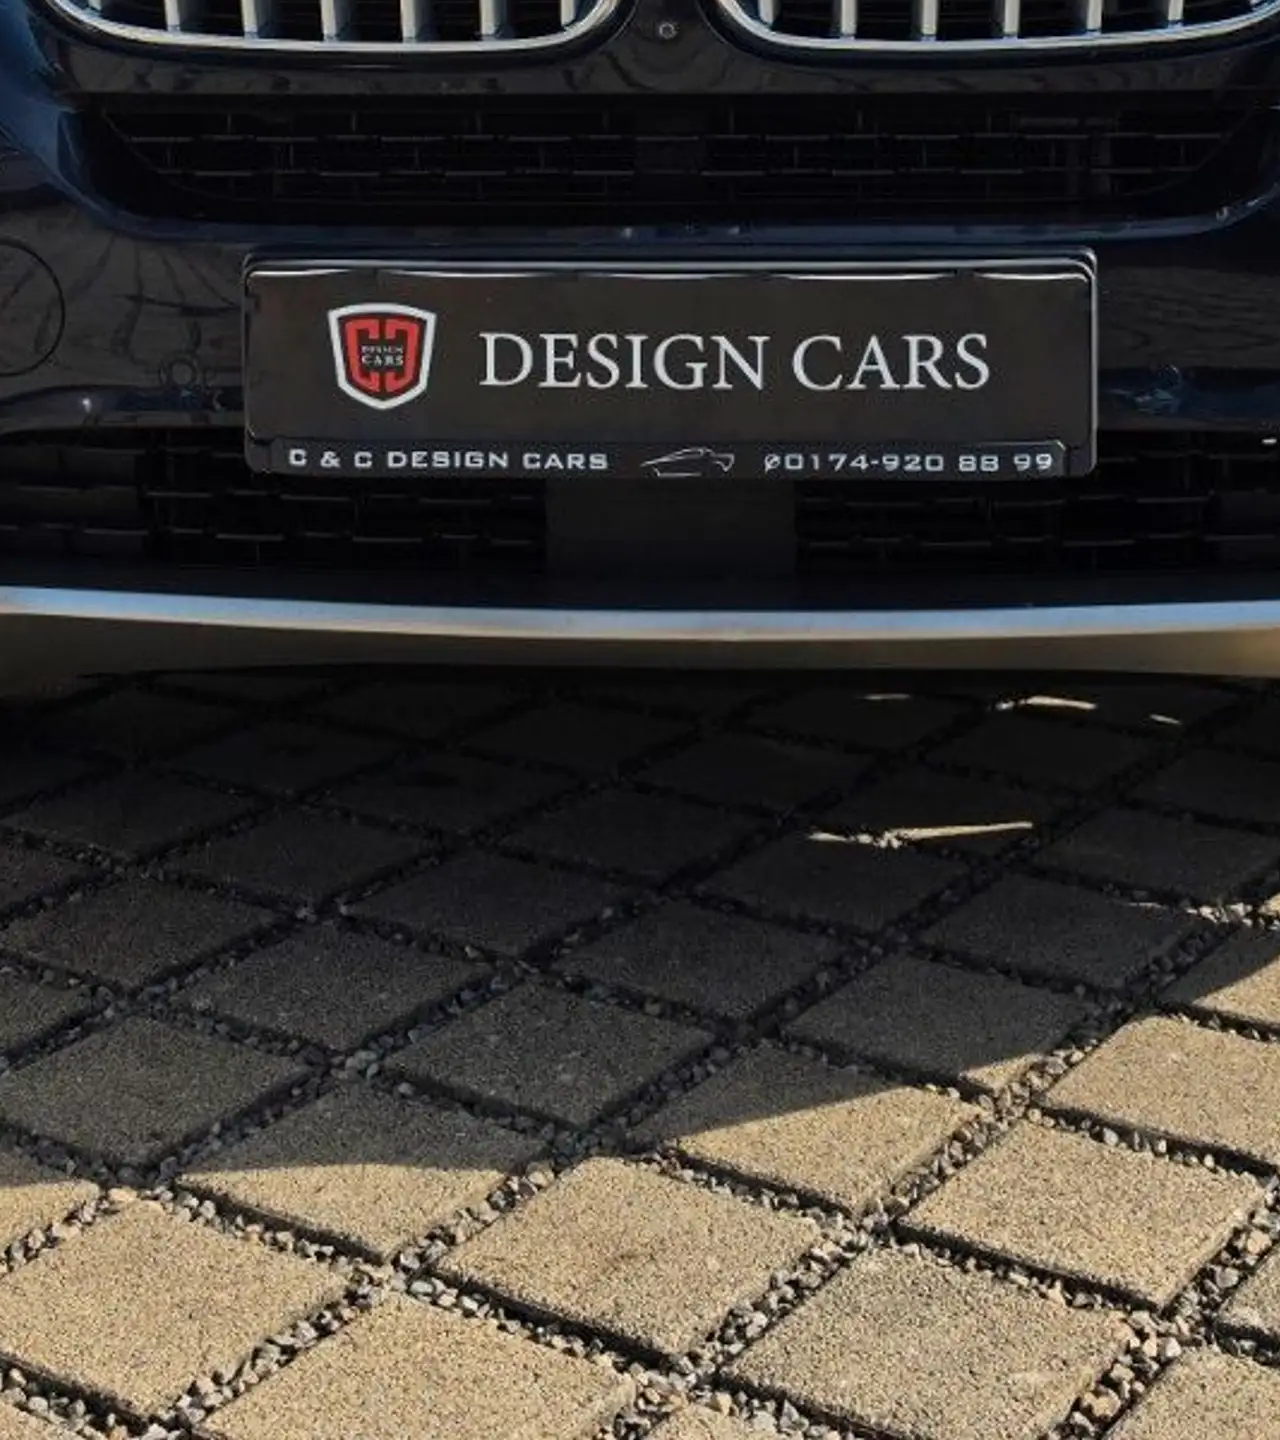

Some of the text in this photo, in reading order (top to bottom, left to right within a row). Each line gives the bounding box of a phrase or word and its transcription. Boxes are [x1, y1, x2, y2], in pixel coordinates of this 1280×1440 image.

[478, 332, 990, 392] DESIGN CARS
[320, 451, 341, 468] &
[387, 451, 509, 469] DESIGN
[522, 452, 608, 470] CARS
[958, 454, 999, 472] 88
[1013, 453, 1053, 472] 99
